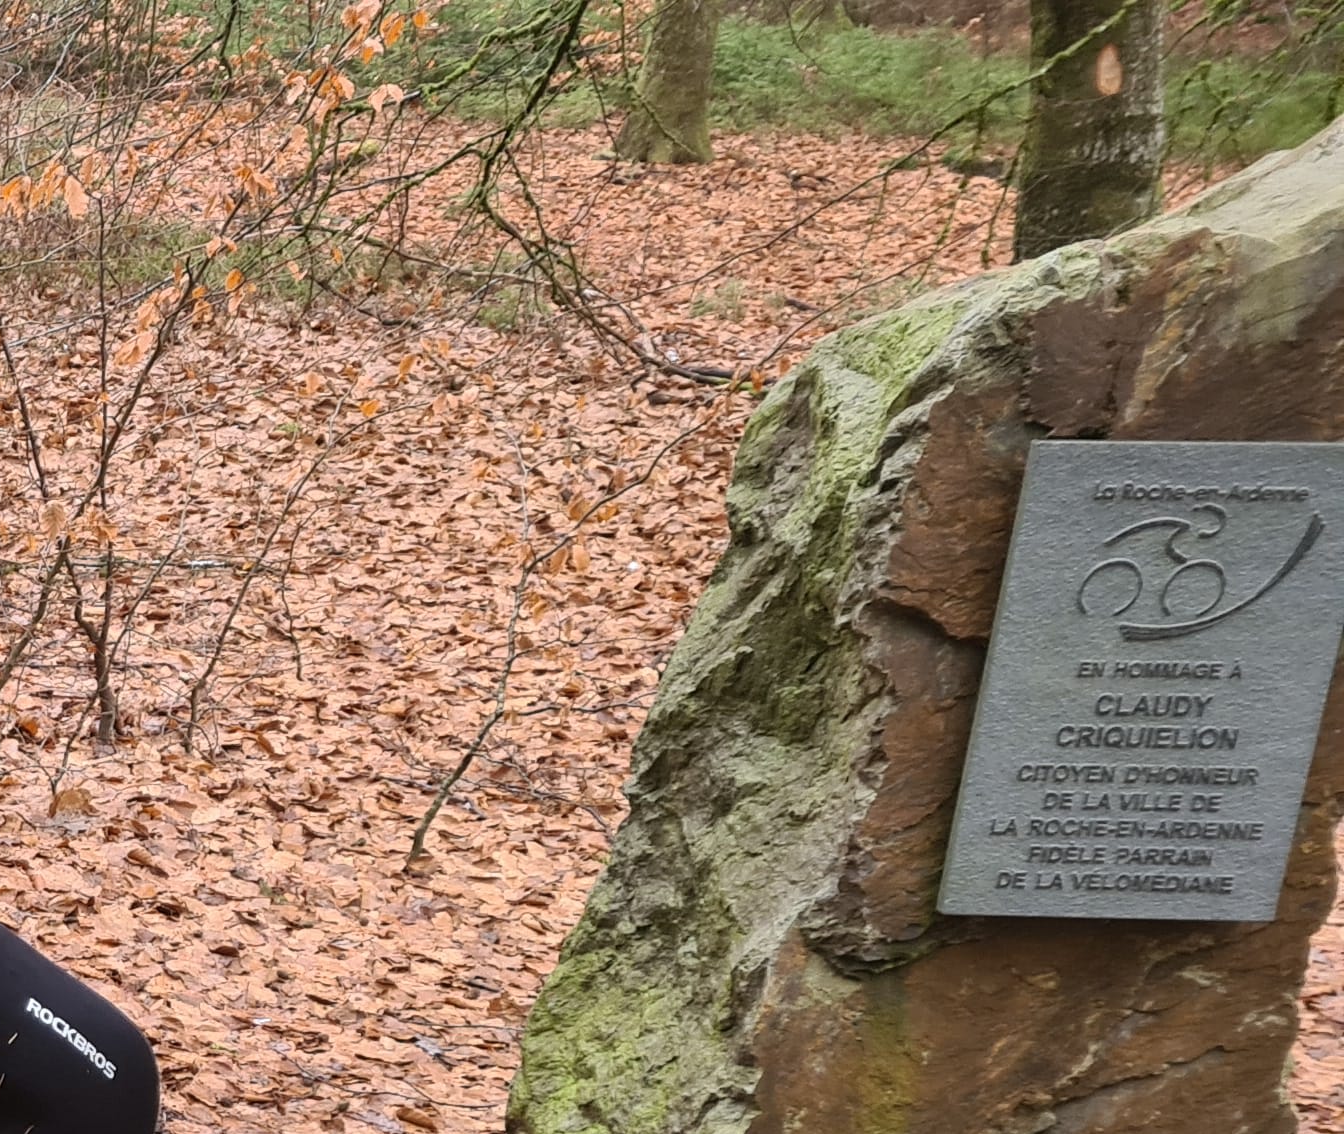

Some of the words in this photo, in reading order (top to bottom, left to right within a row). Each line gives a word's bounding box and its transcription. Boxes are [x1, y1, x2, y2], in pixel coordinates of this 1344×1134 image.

[1077, 661, 1105, 679] EN
[1113, 661, 1223, 680] HOMMAGE
[1095, 693, 1214, 718] CLAUDY
[1056, 724, 1240, 750] CRIQUIELION
[1017, 764, 1116, 784] CITOYEN
[1042, 791, 1076, 811] DE
[1082, 792, 1111, 811] LA
[1120, 793, 1184, 813] VILLE
[1190, 794, 1224, 813] DE
[989, 817, 1018, 836] LA
[1026, 817, 1264, 841] ROCHE-EN-ARDENNE
[1114, 847, 1212, 867] PARRAIN
[996, 871, 1028, 890] DE
[1035, 873, 1063, 891] LA
[26, 997, 117, 1079] ROCKBROS
